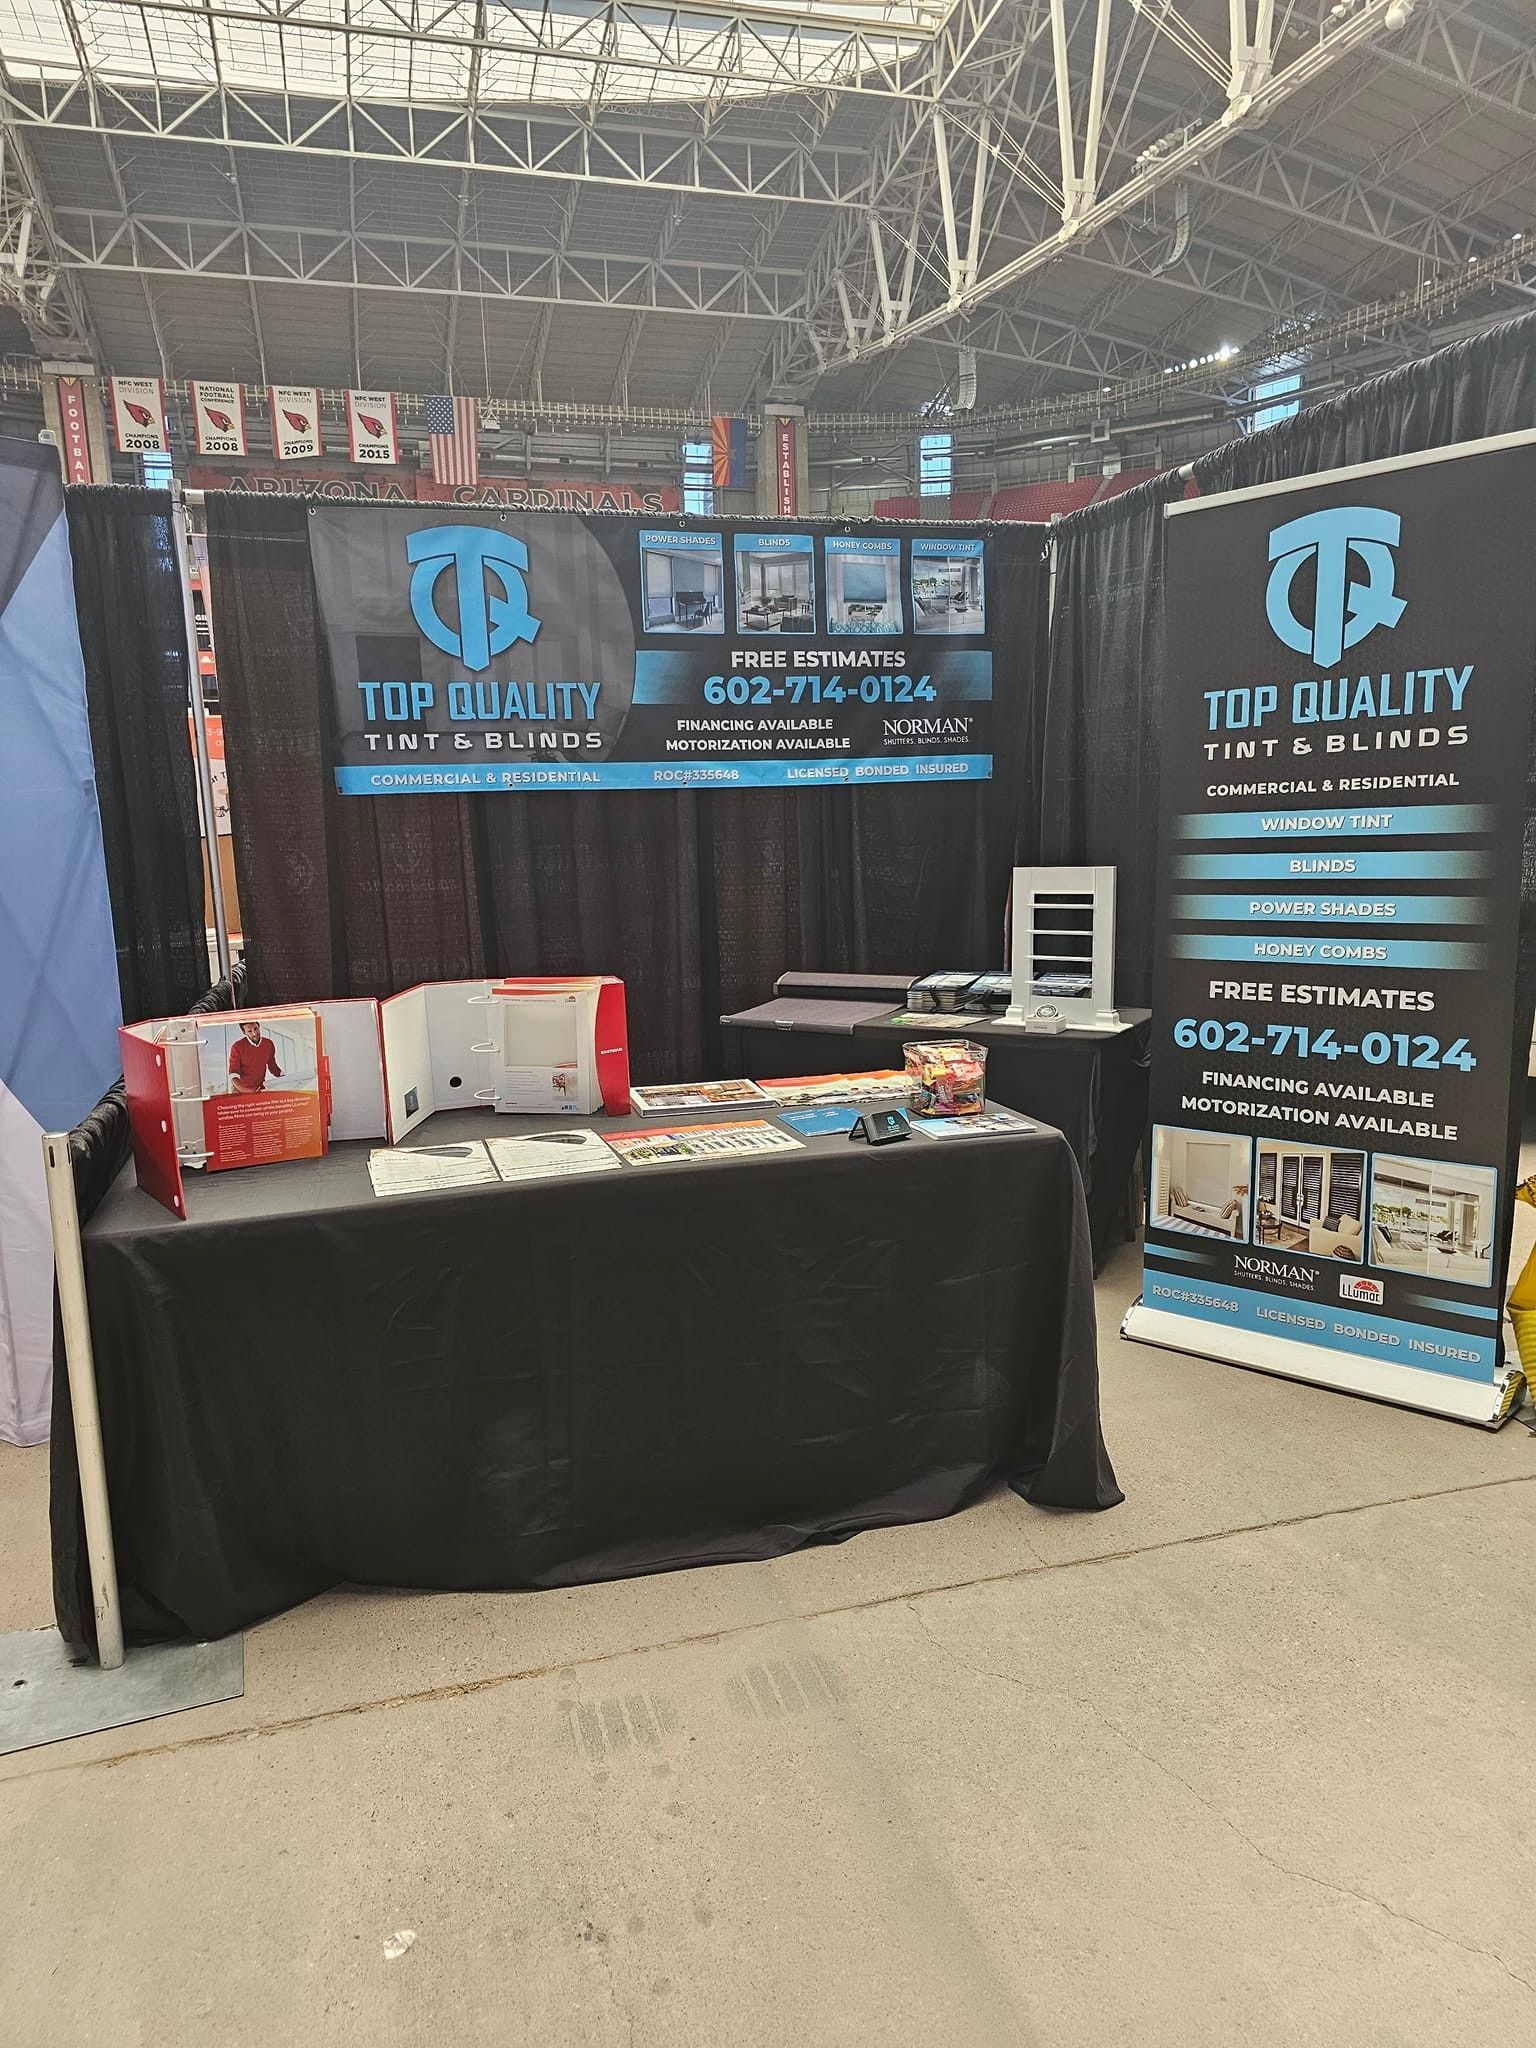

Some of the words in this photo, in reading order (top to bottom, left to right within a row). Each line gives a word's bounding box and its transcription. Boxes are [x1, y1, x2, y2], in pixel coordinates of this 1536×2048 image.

[199, 385, 234, 393] NATIONAL
[278, 396, 312, 404] DIVISION
[354, 401, 387, 409] DIVISION
[125, 439, 160, 449] 2008
[205, 442, 239, 452] 2008
[284, 445, 314, 456] 2009
[359, 449, 390, 459] 2015
[782, 434, 791, 518] ESTABLISH
[453, 486, 664, 513] CARDINALS
[645, 535, 679, 544] POWER
[679, 536, 717, 545] SHADES
[758, 538, 791, 547] BLINDS
[832, 541, 861, 549] HONEY
[862, 542, 893, 550] COMBS
[920, 543, 957, 551] WINDOW
[958, 543, 976, 552] TINT
[731, 650, 788, 668] FREE
[793, 650, 906, 668] ESTIMATES
[703, 675, 938, 705] 602-714-0124
[1203, 685, 1278, 732] TOP
[1291, 664, 1475, 724] QUALITY
[357, 681, 434, 721] TOP
[447, 681, 601, 721] QUALITY
[676, 719, 754, 732] FINANCING
[757, 718, 833, 731] AVAILABLE
[364, 733, 440, 750] TINT
[453, 733, 473, 750] &
[484, 731, 603, 749] BLINDS
[665, 739, 773, 751] MOTORIZATION
[775, 737, 851, 750] AVAILABLE
[1203, 739, 1279, 762] TINT
[1293, 737, 1313, 755] &
[1326, 725, 1469, 754] BLINDS
[370, 772, 481, 786] COMMERCIAL
[486, 772, 497, 783] &
[501, 771, 601, 784] RESIDENTIAL
[653, 769, 740, 782] ROC#335648
[787, 767, 849, 779] LICENSED
[854, 765, 909, 777] BONDED
[915, 762, 969, 775] INSURED
[1206, 780, 1317, 797] COMMERCIAL
[1321, 779, 1334, 792] &
[1338, 772, 1460, 791] RESIDENTIAL
[1261, 815, 1346, 832] WINDOW
[1349, 813, 1394, 829] TINT
[1289, 858, 1357, 874] BLINDS
[1249, 901, 1316, 916] POWER
[1319, 902, 1397, 917] SHADES
[1253, 942, 1316, 958] HONEY
[1319, 944, 1388, 961] COMBS
[1208, 980, 1274, 1002] FREE
[1280, 984, 1436, 1012] ESTIMATES
[1173, 1018, 1478, 1073] 602-714-0124
[1201, 1070, 1309, 1095] FINANCING
[1313, 1082, 1435, 1109] AVAILABLE
[1181, 1095, 1330, 1127] MOTORIZATION
[1334, 1113, 1458, 1141] AVAILABLE
[1152, 1284, 1240, 1313] ROC#335648
[1256, 1306, 1327, 1330] LICENSED
[1333, 1322, 1401, 1347] BONDED
[1408, 1338, 1482, 1364] INSURED
